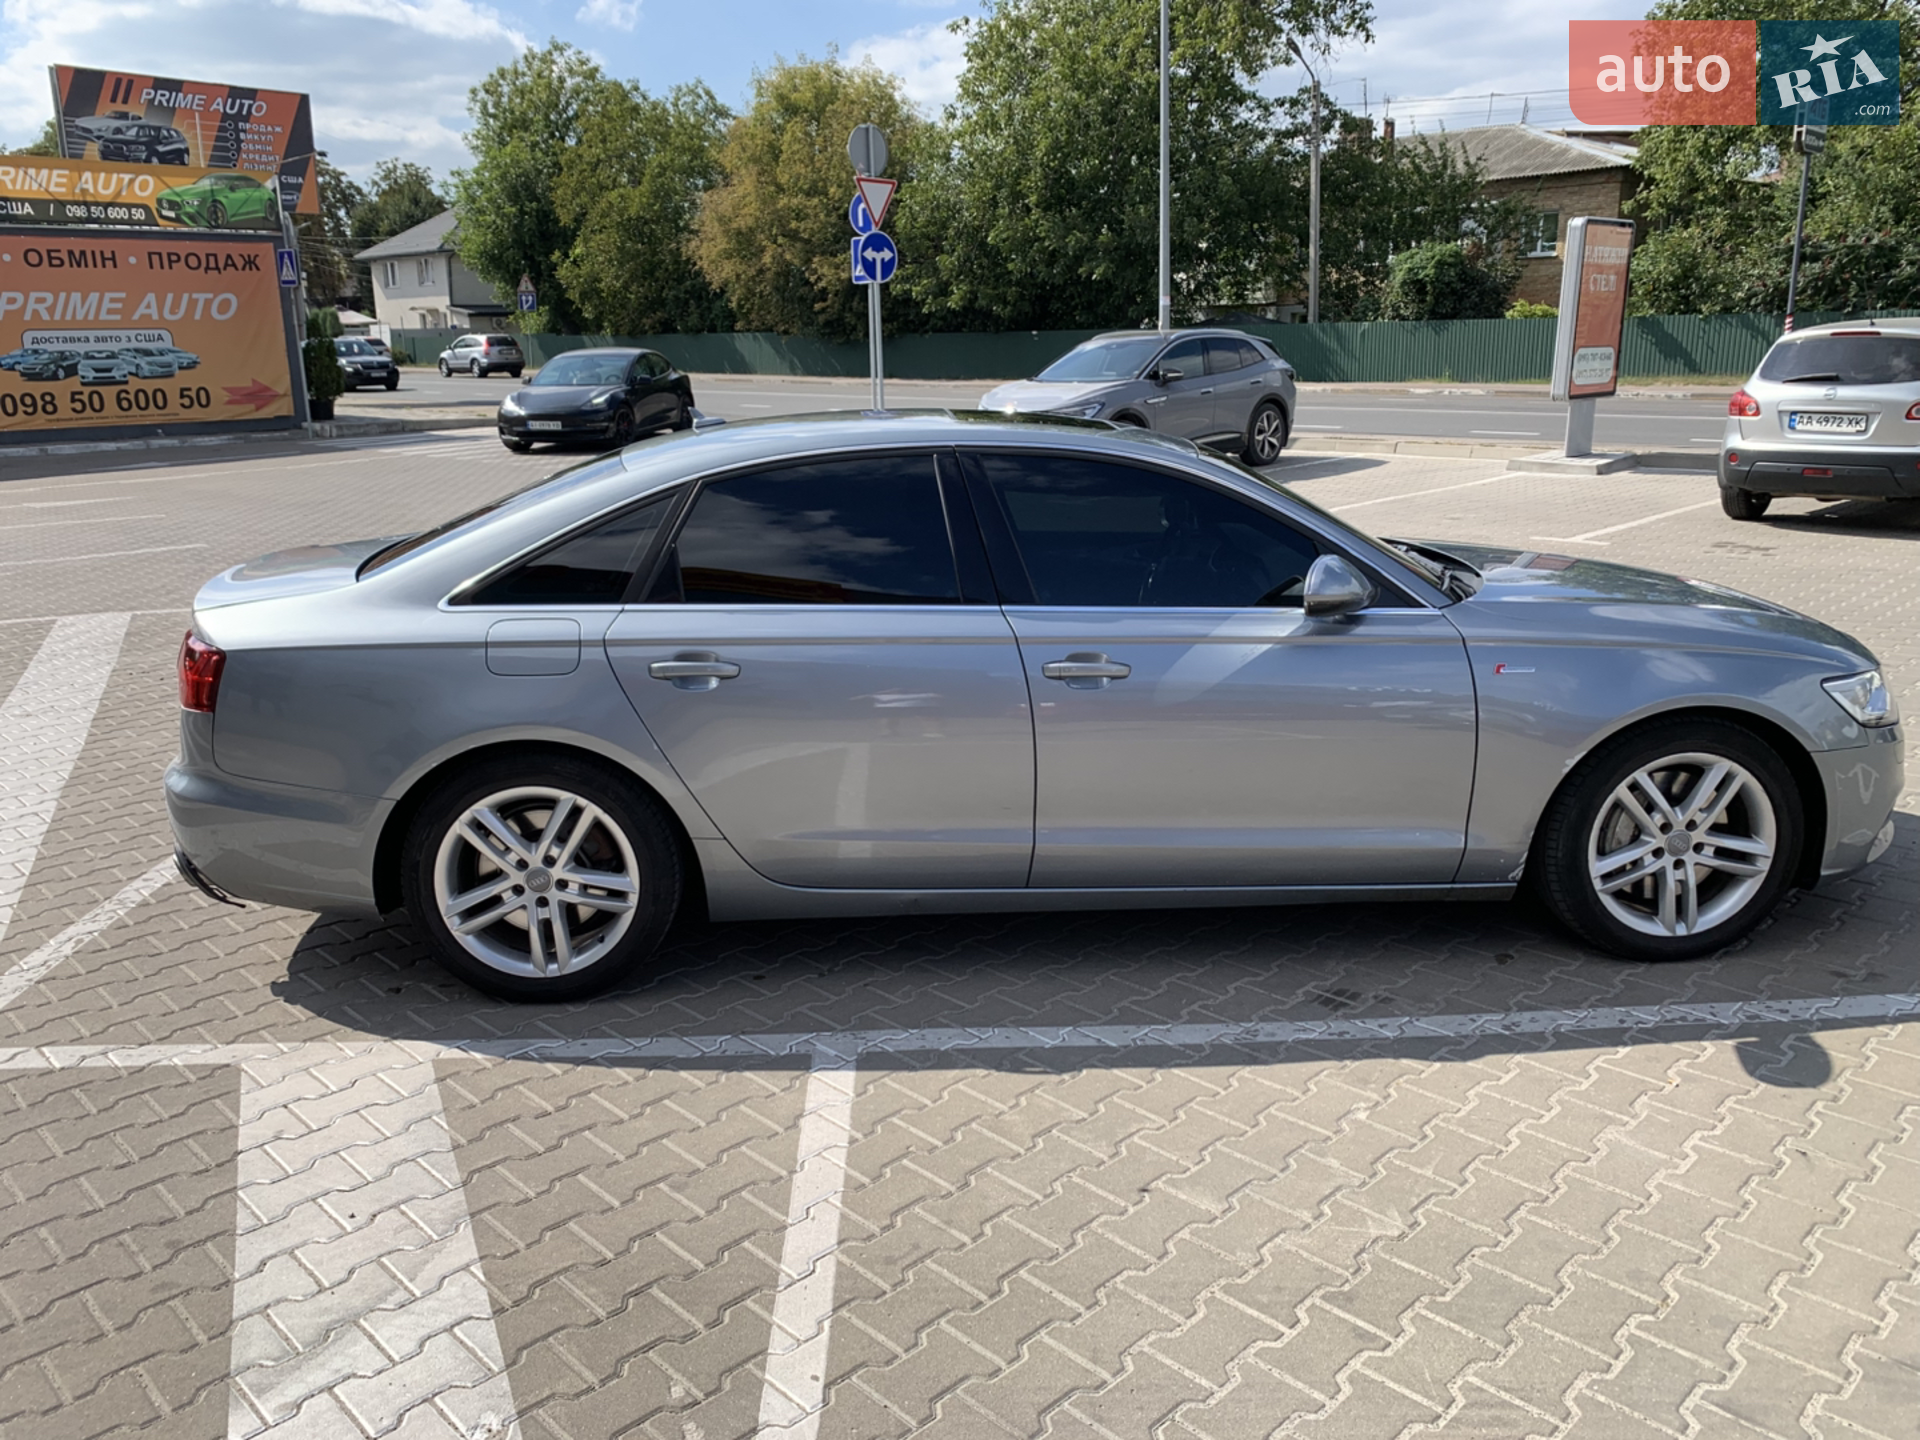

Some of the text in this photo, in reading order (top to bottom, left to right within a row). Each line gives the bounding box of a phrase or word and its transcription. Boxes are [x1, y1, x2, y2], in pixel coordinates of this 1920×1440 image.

[140, 88, 267, 117] PRIME AUTO
[238, 122, 284, 133] ПРОДАЖ
[239, 132, 274, 142] ВИКУП
[240, 142, 273, 152] ОБМІН
[242, 152, 280, 163] КРЕДИТ
[74, 170, 155, 197] AUTO
[65, 204, 88, 217] 098
[90, 206, 105, 218] 50
[107, 206, 129, 219] 600
[131, 208, 146, 220] 50
[23, 248, 261, 275] ОБМІН ПРОДАЖ
[0, 291, 238, 321] PRIME AUTO
[31, 334, 90, 346] доставка
[94, 334, 122, 344] авто
[134, 333, 165, 344] США
[0, 386, 211, 417] 098 50 600 50
[1797, 415, 1864, 429] AA 4972 XK
